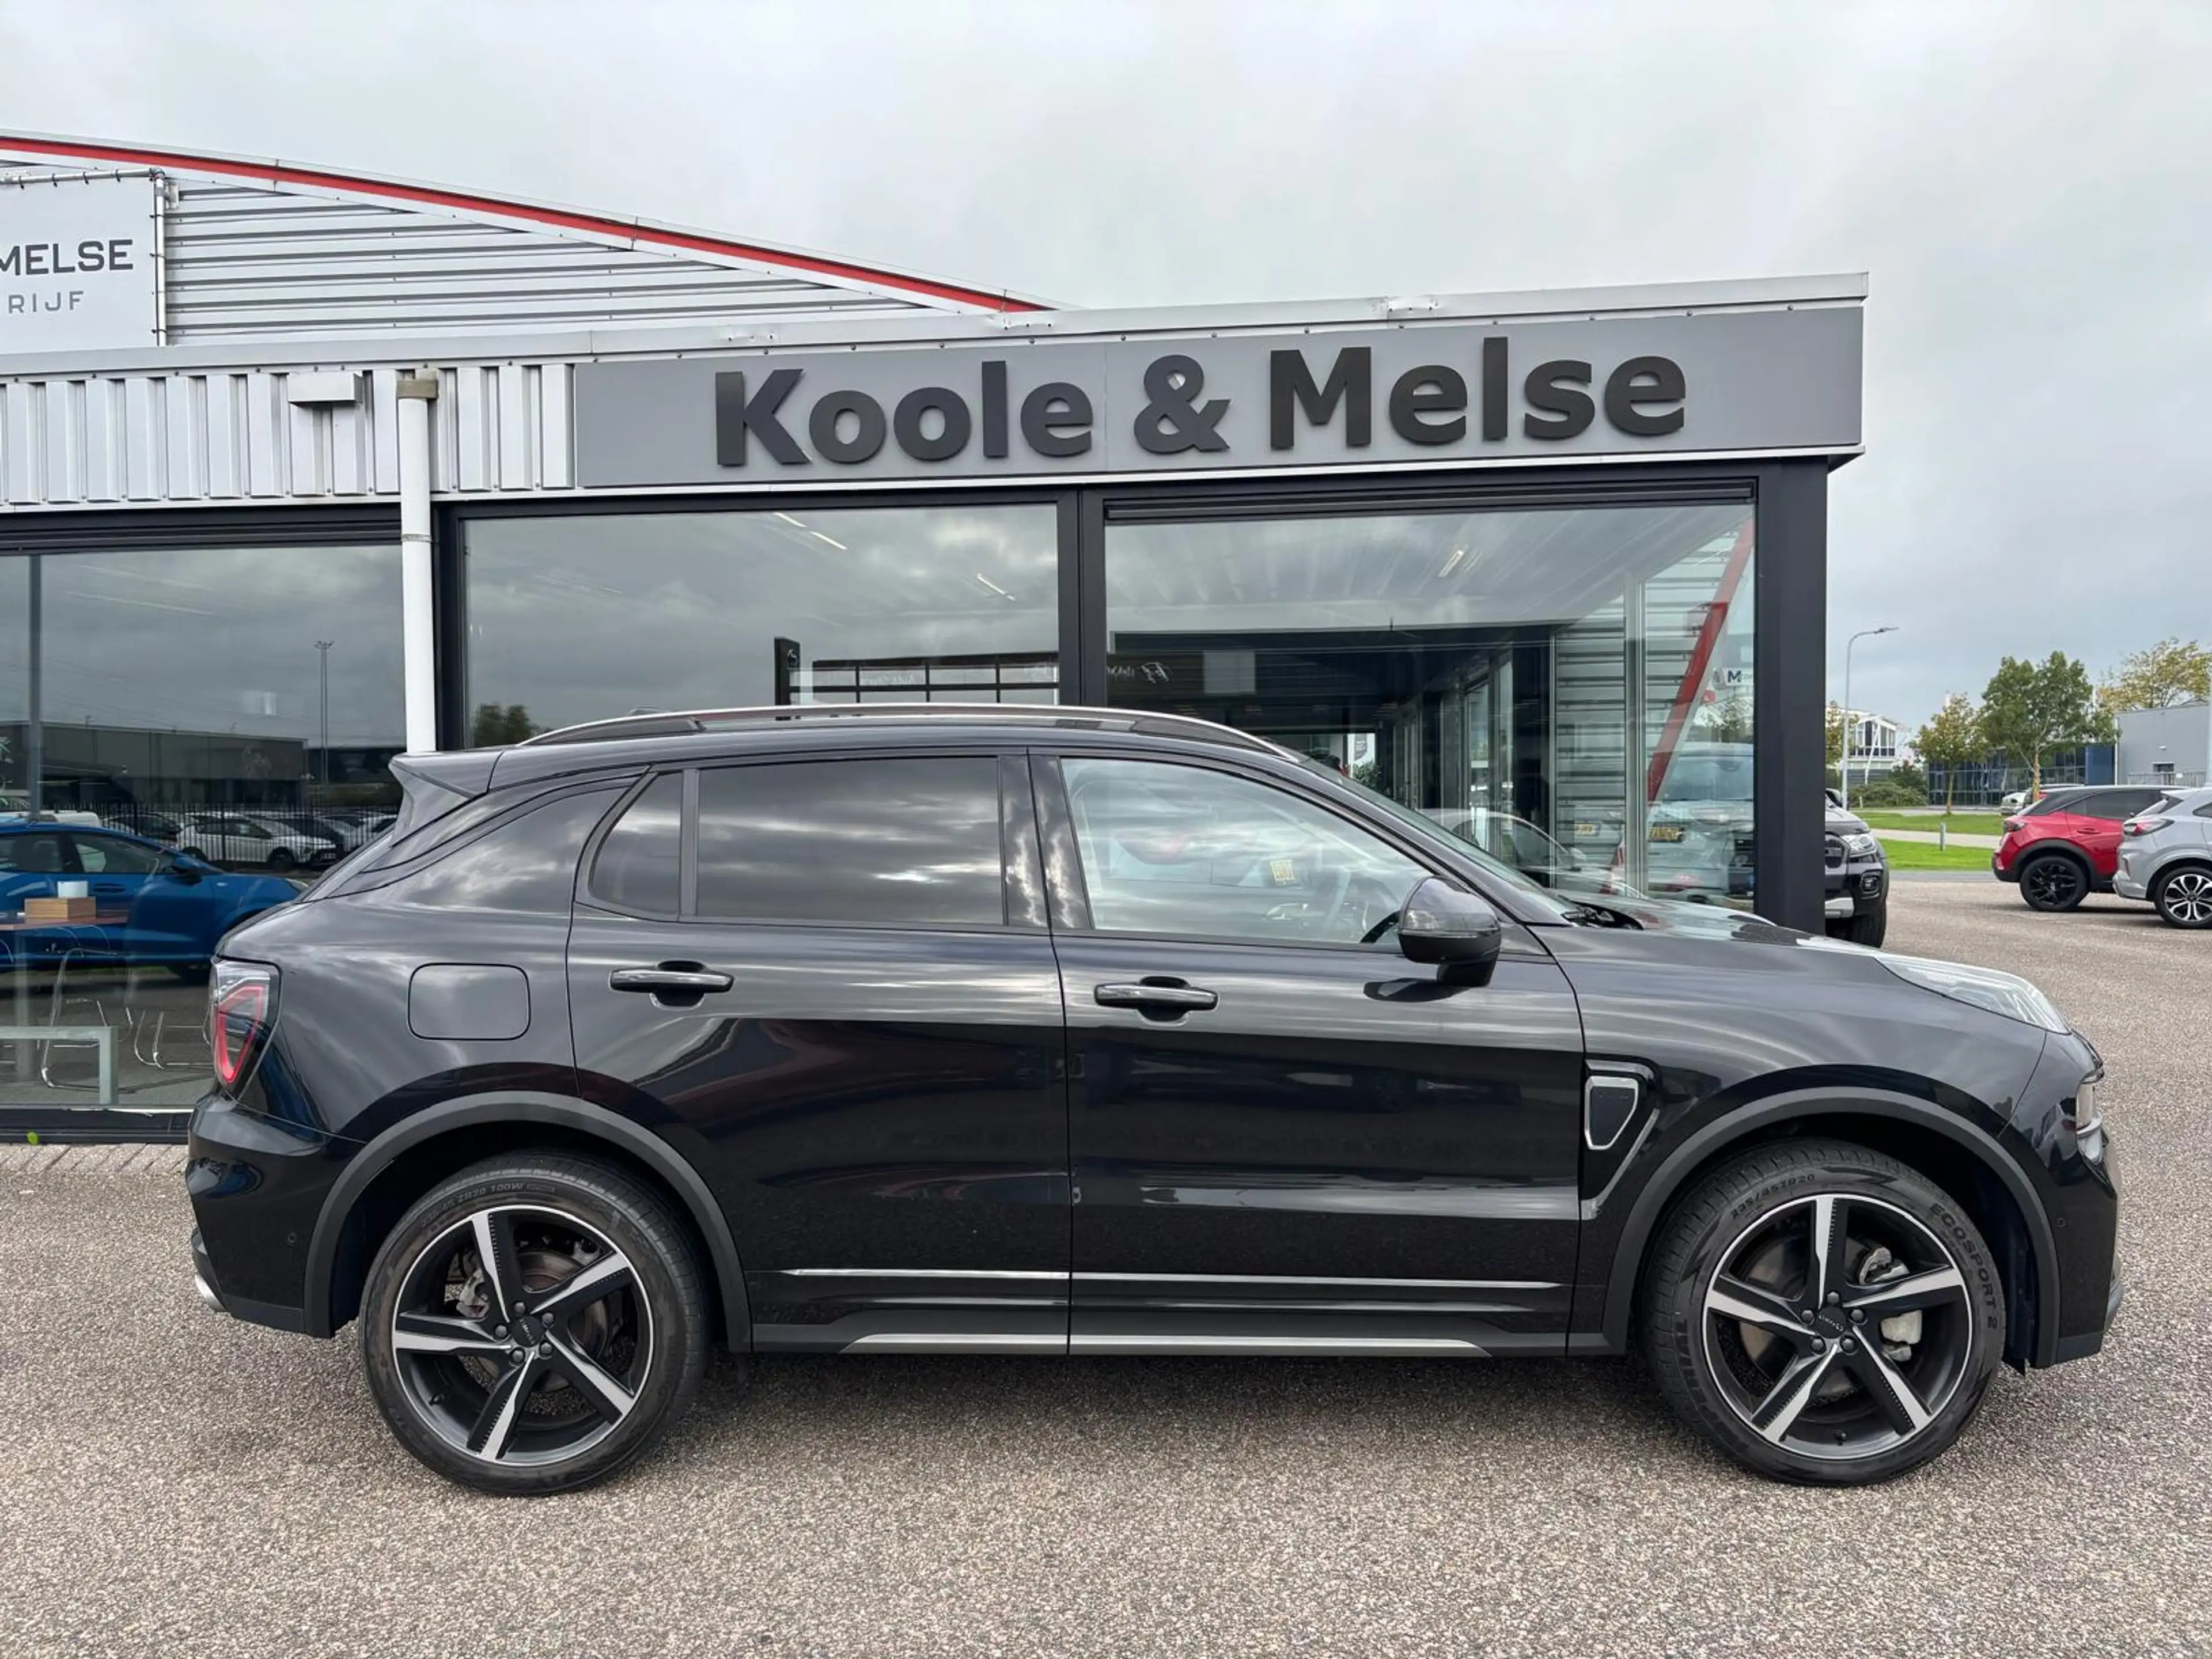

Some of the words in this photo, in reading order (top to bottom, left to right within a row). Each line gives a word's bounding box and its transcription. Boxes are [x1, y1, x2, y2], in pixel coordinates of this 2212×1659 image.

[0, 239, 133, 276] MELSE
[8, 290, 84, 313] RIJF
[715, 361, 1094, 466] Koole
[1134, 354, 1231, 454] &
[1270, 336, 1687, 449] Melse
[1930, 1202, 1997, 1309] ECOSPORT
[1988, 1315, 1998, 1330] 2
